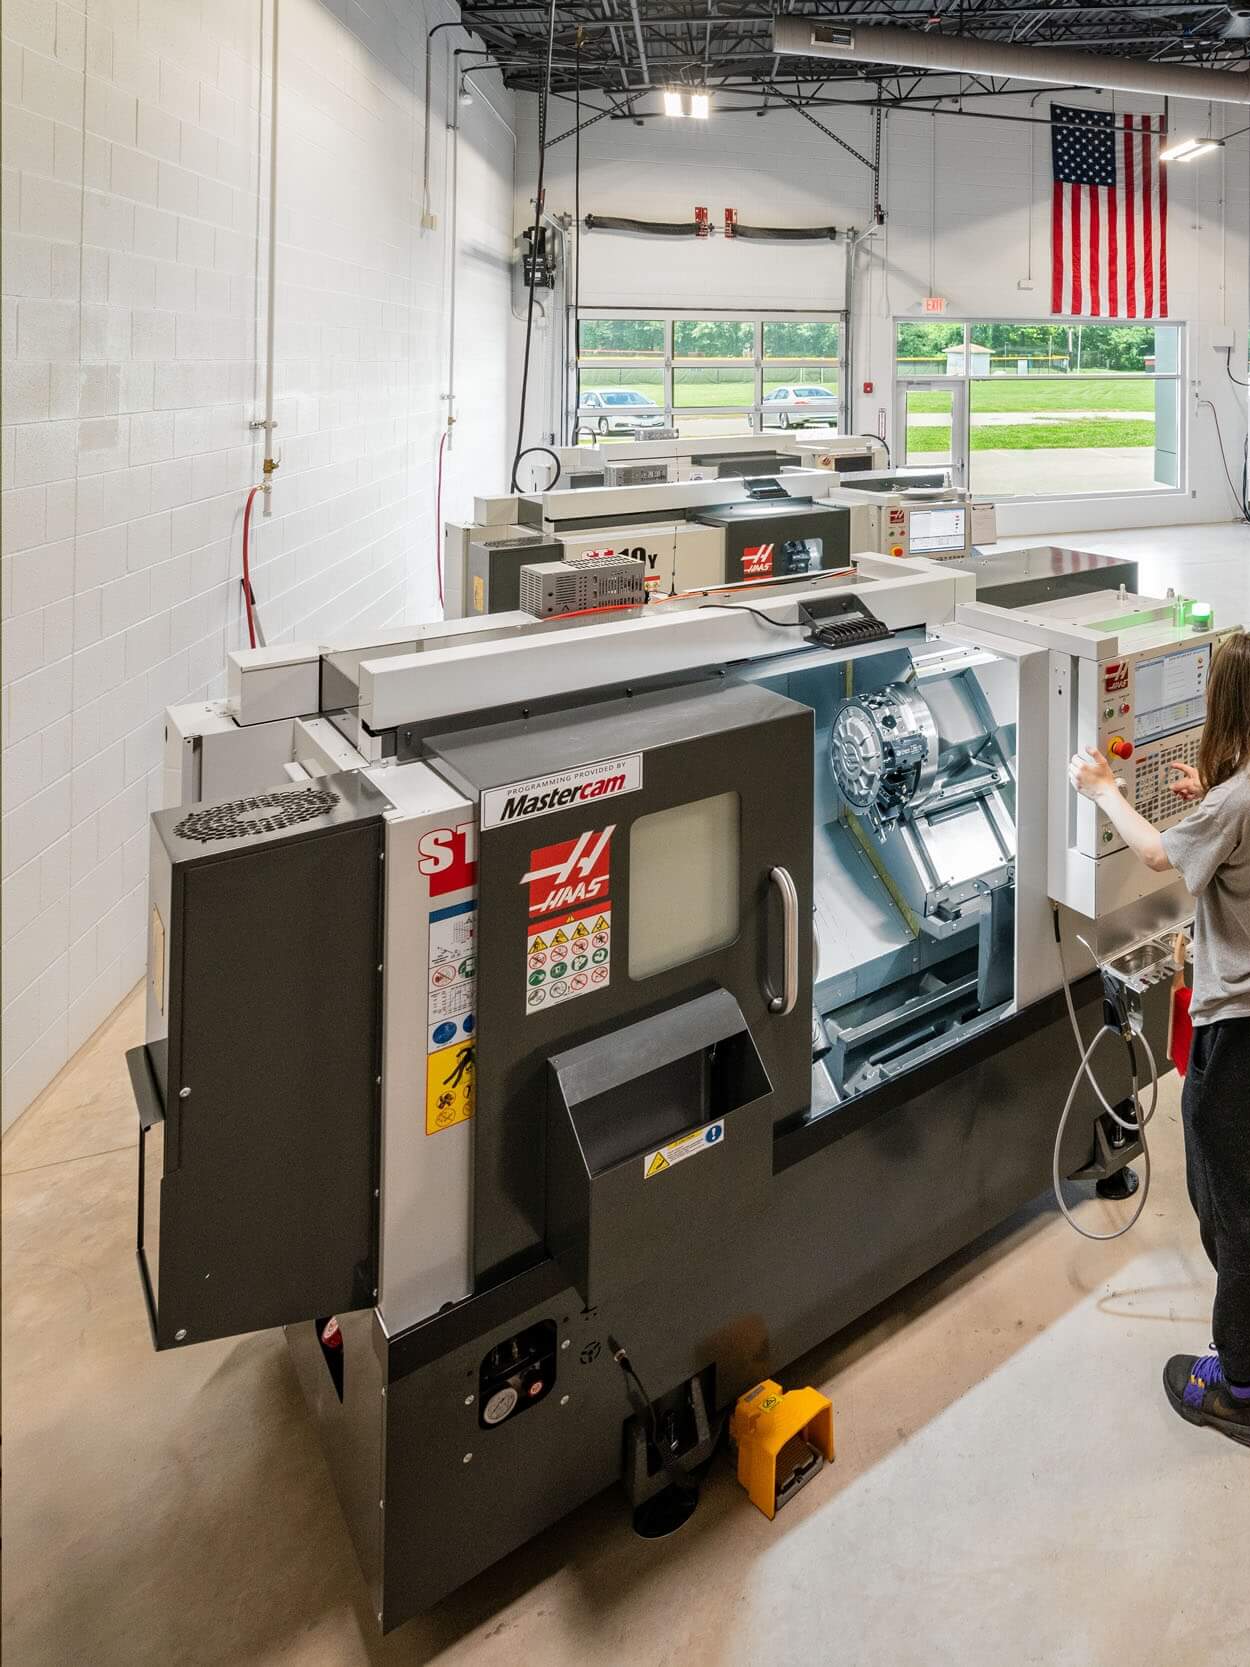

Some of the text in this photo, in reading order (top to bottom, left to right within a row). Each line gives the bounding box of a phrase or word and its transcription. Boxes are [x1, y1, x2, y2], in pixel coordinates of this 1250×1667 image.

[926, 299, 944, 312] EXIT
[507, 761, 627, 796] PROGRAMMING PROVIDED BY
[500, 774, 626, 821] Mastercam
[529, 874, 609, 912] HAAS
